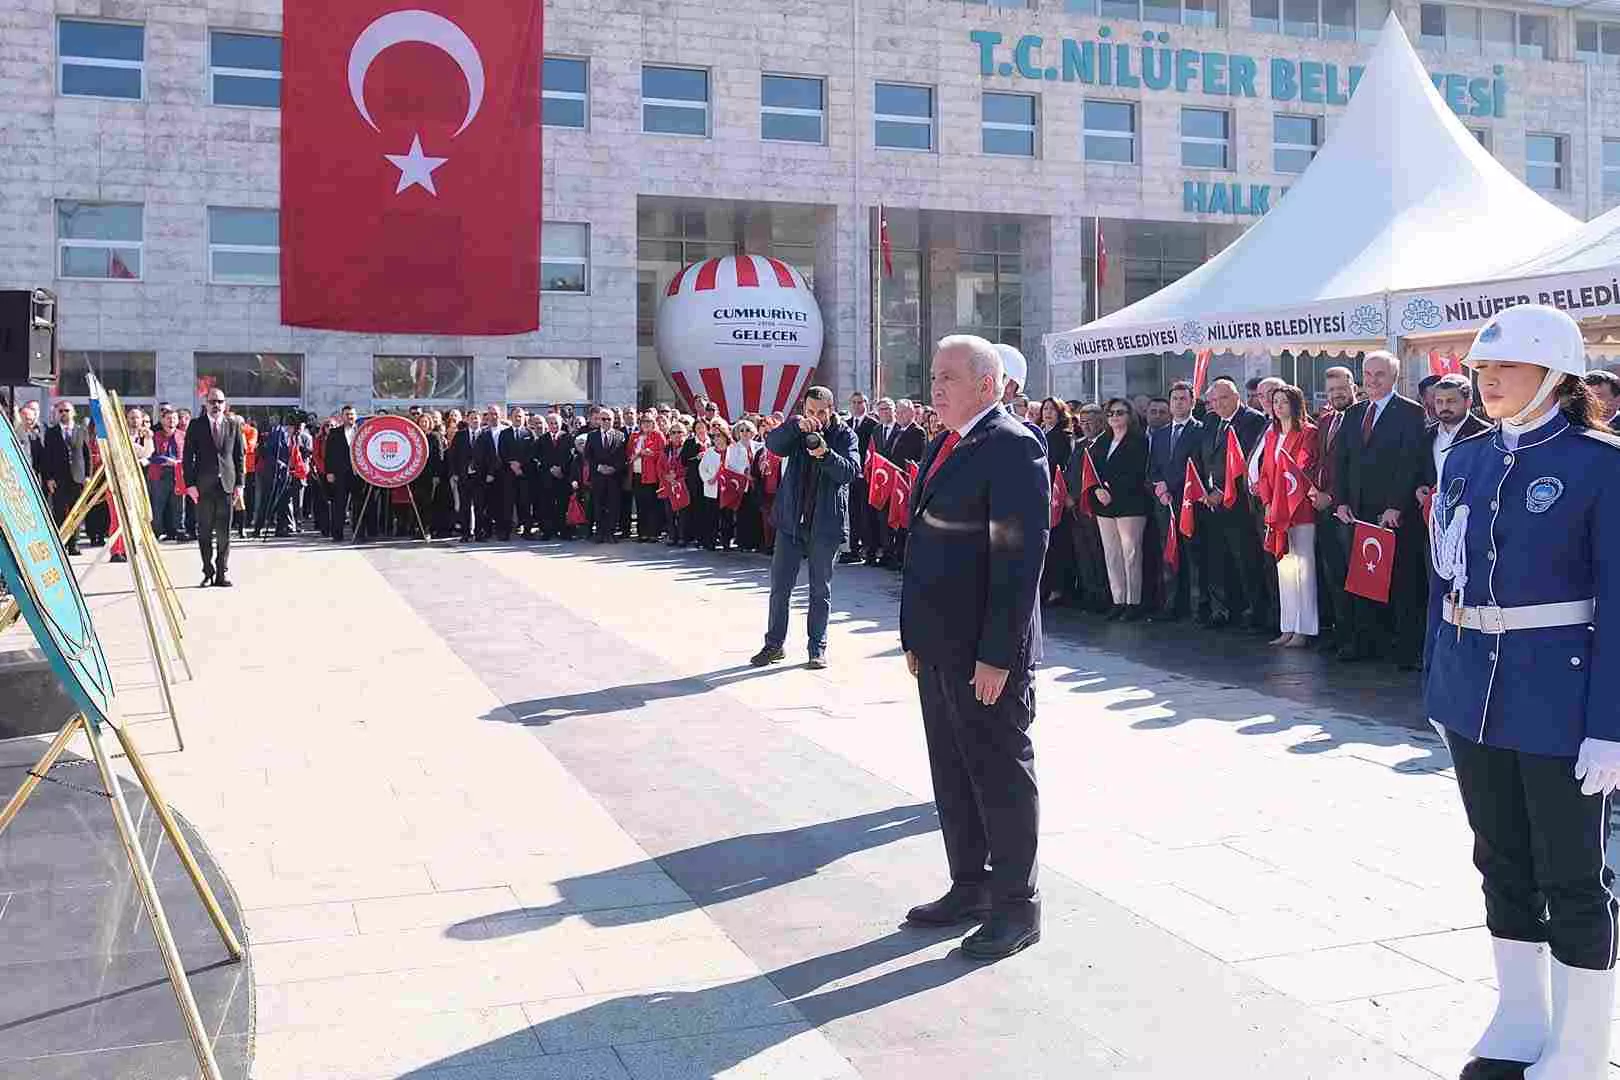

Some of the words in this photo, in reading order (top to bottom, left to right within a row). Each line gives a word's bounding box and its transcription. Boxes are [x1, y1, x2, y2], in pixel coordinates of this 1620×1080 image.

[1183, 180, 1271, 216] HALK
[713, 307, 808, 322] CUMHURİYET
[1208, 320, 1261, 340] NİLÜFER
[1265, 311, 1346, 337] BELEDİYESİ
[732, 329, 798, 341] GELECEK
[1073, 337, 1116, 356] NİLÜFER
[1116, 326, 1178, 350] BELEDİYESİ
